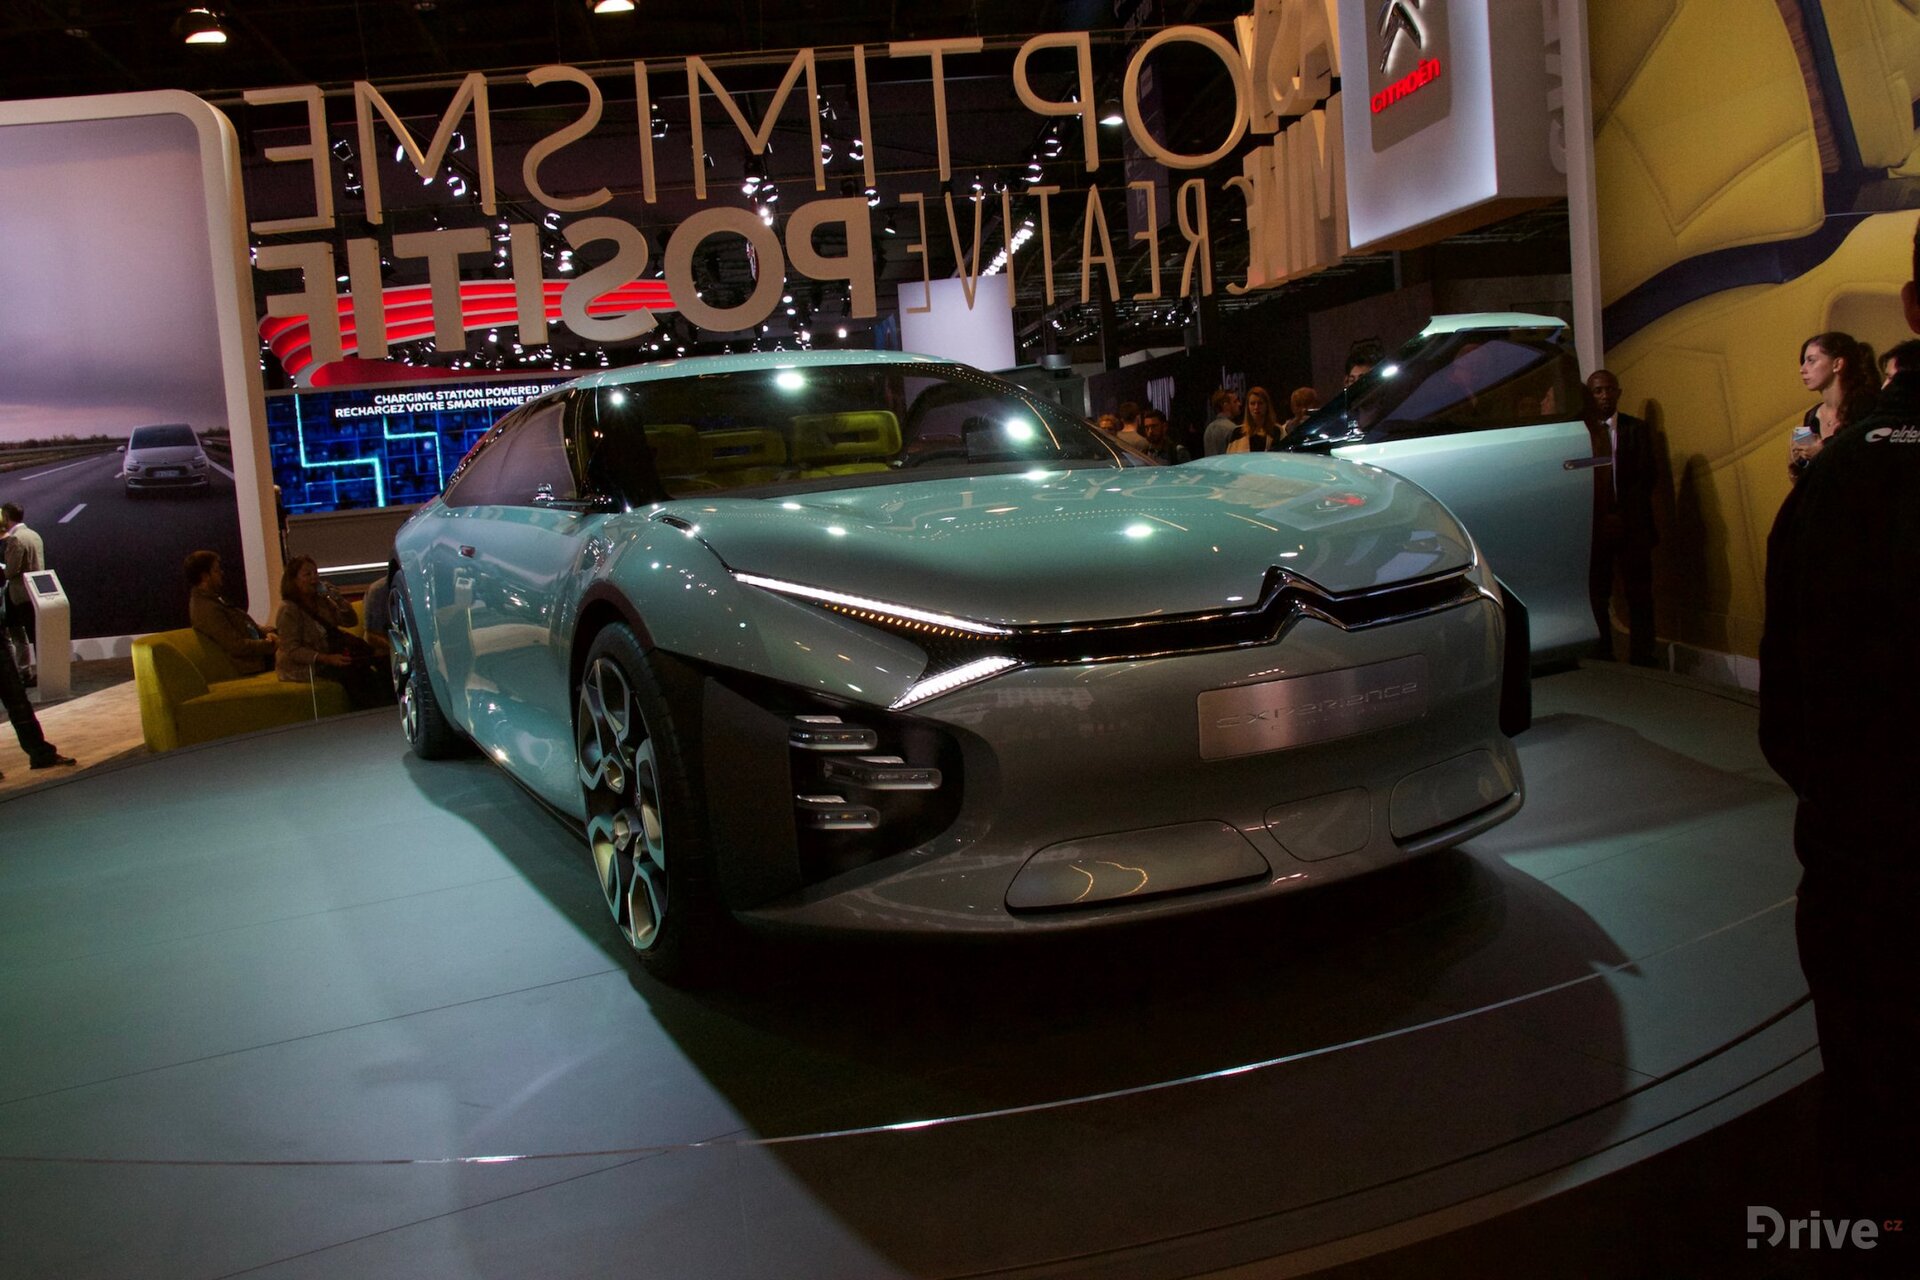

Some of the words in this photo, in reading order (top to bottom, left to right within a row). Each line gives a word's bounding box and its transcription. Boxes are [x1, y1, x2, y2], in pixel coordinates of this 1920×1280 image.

[374, 391, 434, 406] CHARGING
[435, 388, 481, 401] STATION
[485, 385, 540, 398] POWERED
[335, 403, 406, 419] RECHARGEZ
[406, 401, 445, 413] VOTRE
[446, 397, 525, 411] SMARTPHONE
